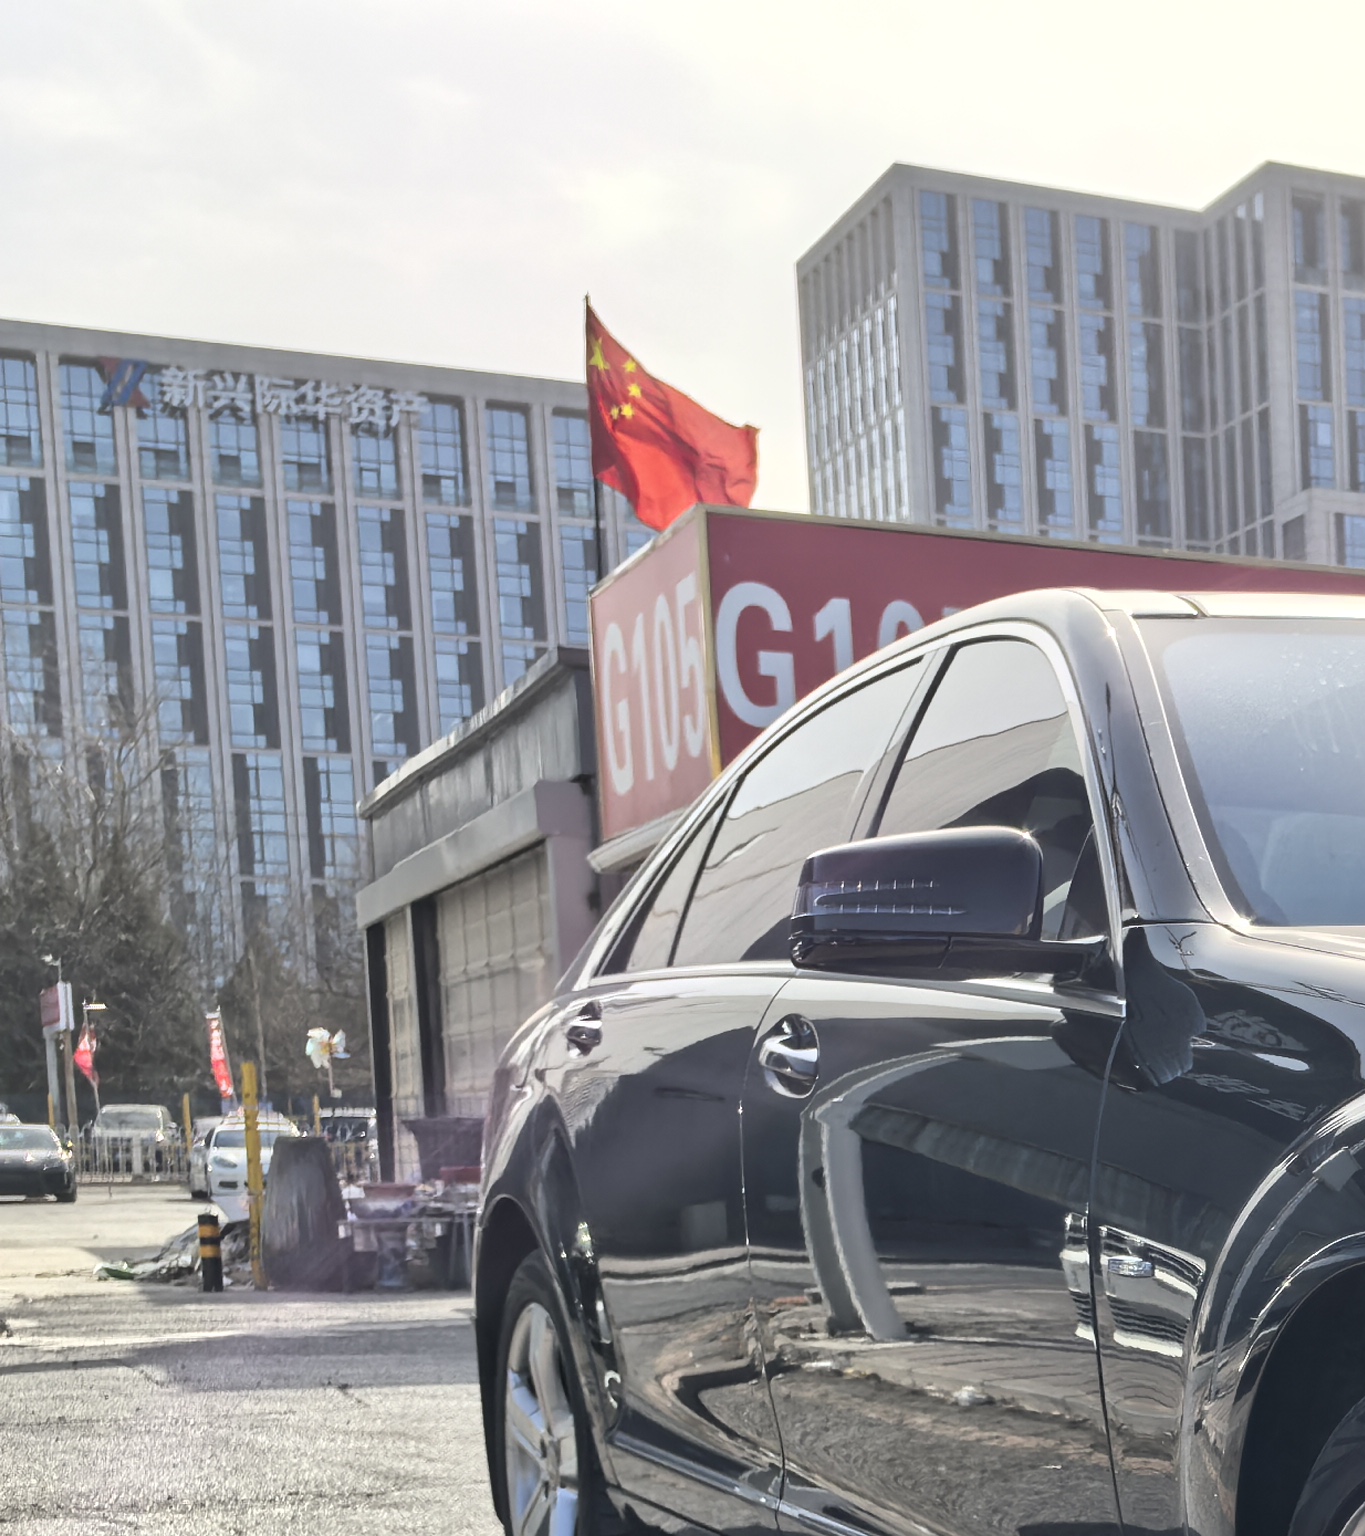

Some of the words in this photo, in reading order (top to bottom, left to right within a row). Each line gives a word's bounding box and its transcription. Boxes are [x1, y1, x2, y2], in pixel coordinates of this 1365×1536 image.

[160, 364, 431, 429] 新兴际华资产
[603, 572, 704, 797] G105
